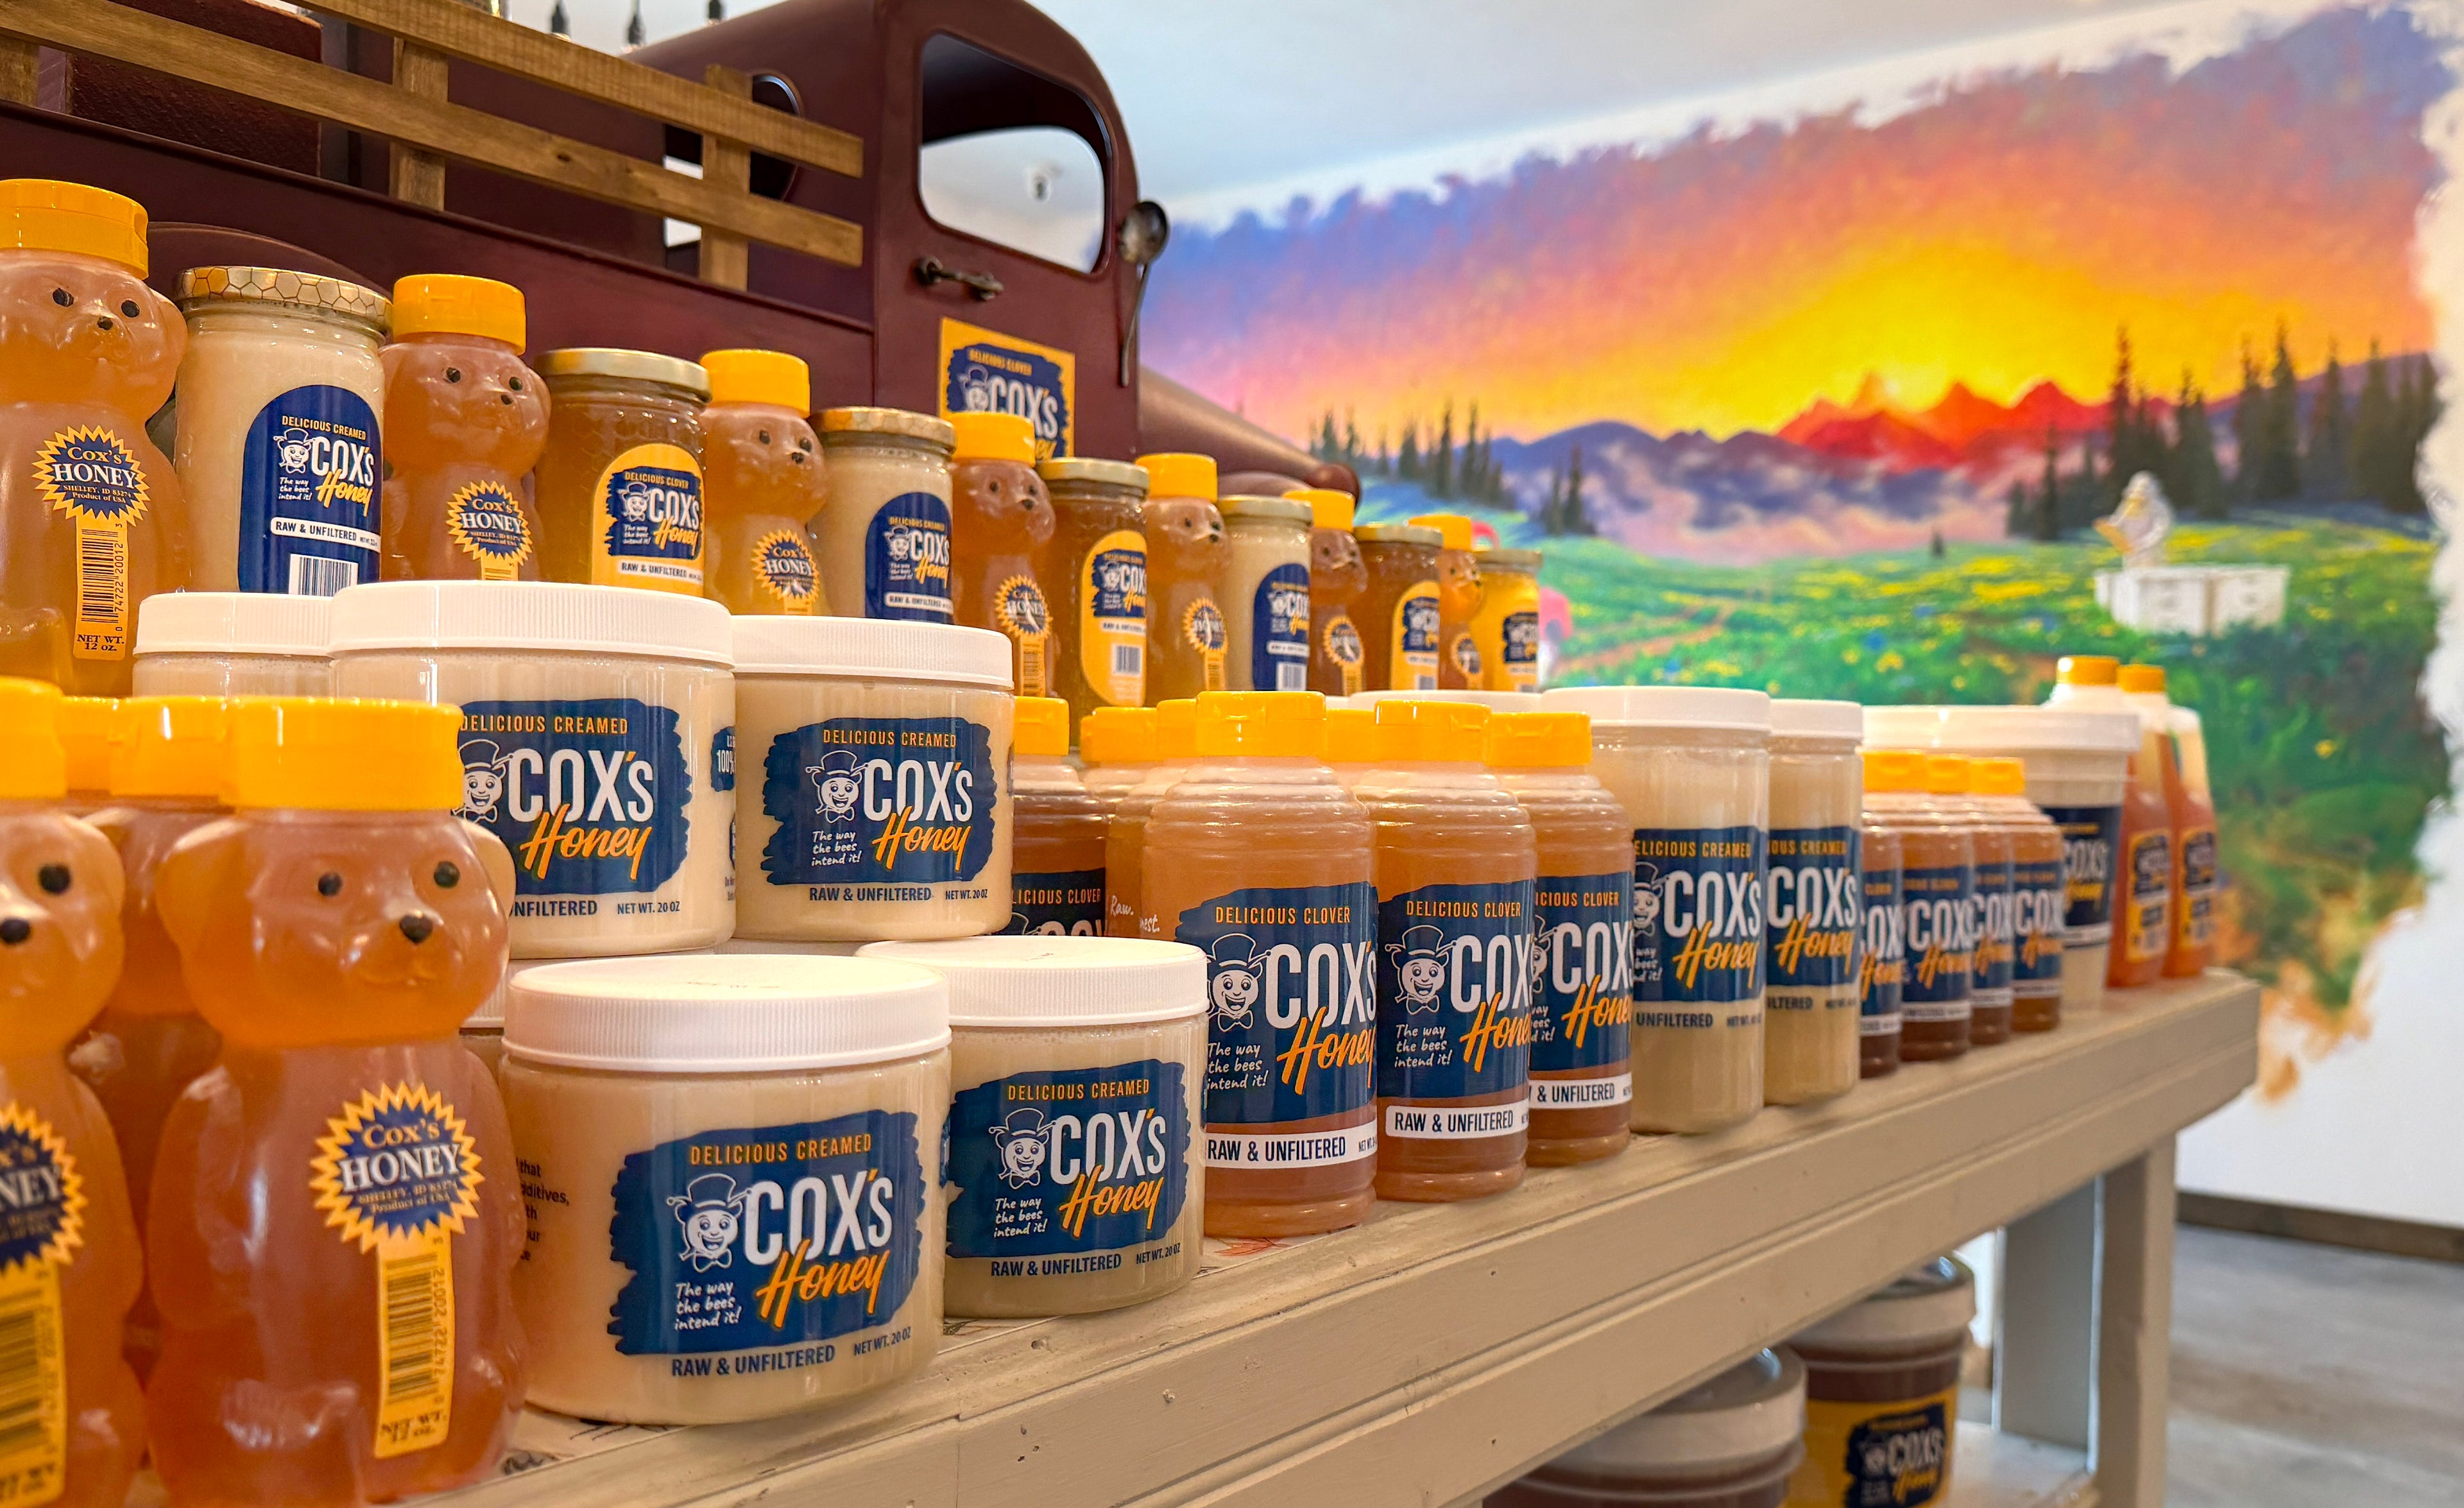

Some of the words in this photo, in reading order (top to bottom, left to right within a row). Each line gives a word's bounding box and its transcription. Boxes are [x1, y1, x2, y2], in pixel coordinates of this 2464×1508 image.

[282, 416, 331, 432] DELICIOUS
[334, 424, 366, 440] CREAMED
[67, 447, 122, 464] Cox's
[53, 463, 136, 489] HONEY
[279, 477, 293, 485] The
[295, 479, 309, 487] way
[625, 472, 664, 484] DELICIOUS
[667, 477, 689, 490] CLOVER
[315, 468, 373, 517] Honey
[472, 499, 512, 513] Cox's
[276, 521, 296, 532] RAW
[300, 524, 306, 533] &
[310, 525, 357, 542] UNFILTERED
[460, 513, 522, 534] HONEY
[653, 516, 699, 557] Honey
[622, 562, 638, 571] RAW
[649, 566, 687, 578] UNFILTERED
[766, 559, 814, 576] HONEY
[914, 554, 949, 589] Honey
[77, 635, 100, 643] NET
[104, 635, 124, 644] WT.
[459, 714, 545, 733] DELICIOUS
[554, 717, 628, 735] CREAMED
[823, 729, 894, 746] DELICIOUS
[902, 732, 957, 748] CREAMED
[520, 803, 653, 881] Honey
[813, 831, 832, 842] The
[836, 832, 855, 843] way
[872, 806, 971, 871] Honey
[813, 843, 831, 854] the
[834, 843, 857, 853] bees
[1634, 840, 1696, 857] ELICIOUS
[1702, 841, 1751, 859] CREAMED
[1801, 840, 1847, 855] CREAMED
[812, 855, 846, 867] intend
[848, 853, 862, 863] it!
[810, 887, 840, 902] RAW
[843, 887, 853, 902] &
[857, 887, 932, 902] UNFILTERED
[945, 890, 959, 900] NET
[960, 889, 971, 899] WT.
[973, 889, 980, 898] 20
[980, 889, 988, 898] OZ
[1013, 889, 1063, 904] LICIOUS
[1068, 889, 1100, 904] CLOVER
[1583, 892, 1619, 907] CLOVER
[617, 903, 635, 915] NET
[638, 902, 655, 913] WT.
[658, 902, 668, 913] 20
[670, 901, 680, 912] OZ
[1110, 895, 1134, 916] Raw.
[1407, 900, 1478, 918] DELICIOUS
[1485, 902, 1521, 917] CLOVER
[1215, 907, 1296, 925] DELICIOUS
[1303, 907, 1351, 925] CLOVER
[1908, 899, 1973, 952] COX
[1774, 913, 1854, 976] Honey
[1672, 920, 1759, 990] Honey
[1561, 974, 1632, 1049] Hone
[1637, 1012, 1713, 1027] UNFILTERED
[1396, 1024, 1419, 1038] The
[1423, 1025, 1446, 1039] way
[1460, 991, 1530, 1073] Hone
[1208, 1042, 1231, 1056] The
[1236, 1043, 1260, 1058] way
[1276, 1006, 1376, 1096] Honey
[1396, 1040, 1417, 1052] the
[1421, 1040, 1448, 1051] bees
[1208, 1062, 1229, 1074] the
[1234, 1059, 1263, 1071] bees
[1394, 1056, 1433, 1068] intend
[1438, 1050, 1453, 1065] it!
[1207, 1077, 1247, 1090] intend
[1252, 1070, 1268, 1086] it!
[1008, 1084, 1084, 1101] DELICIOUS
[1091, 1079, 1150, 1099] CREAMED
[1537, 1086, 1547, 1102] &
[1552, 1083, 1614, 1102] UNFILTERED
[1395, 1112, 1426, 1131] RAW
[1432, 1113, 1442, 1133] &
[1448, 1110, 1514, 1132] UNFILTERED
[362, 1118, 441, 1149] Cox's
[690, 1144, 788, 1165] DELICIOUS
[796, 1133, 871, 1160] CREAMED
[1208, 1139, 1242, 1160] RAW
[1247, 1141, 1258, 1161] &
[1265, 1136, 1346, 1161] UNFILTERED
[339, 1143, 461, 1192] HONEY
[520, 1160, 541, 1177] that
[0, 1165, 61, 1209] NEY
[995, 1197, 1016, 1211] The
[1020, 1197, 1042, 1210] way
[1059, 1164, 1164, 1238] Honey
[996, 1212, 1014, 1224] the
[1019, 1210, 1043, 1221] bees
[993, 1225, 1030, 1237] intend
[1033, 1219, 1048, 1233] it!
[991, 1260, 1024, 1276] RAW
[1027, 1260, 1038, 1276] &
[1042, 1253, 1122, 1276] UNFILTERED
[1136, 1251, 1150, 1265] NET
[1150, 1248, 1164, 1262] WT.
[1165, 1246, 1172, 1257] 20
[1173, 1242, 1181, 1255] OZ
[676, 1283, 701, 1298] The
[706, 1281, 734, 1296] way
[756, 1239, 890, 1328] Honey
[676, 1301, 701, 1315] the
[705, 1297, 735, 1310] bees
[674, 1315, 719, 1331] intend
[724, 1306, 742, 1324] it!
[672, 1358, 712, 1376] RAW
[717, 1357, 730, 1375] &
[735, 1344, 835, 1375] UNFILTERED
[853, 1341, 872, 1356] NET
[873, 1337, 890, 1350] WT.
[891, 1332, 900, 1345] 20
[900, 1326, 911, 1342] OZ
